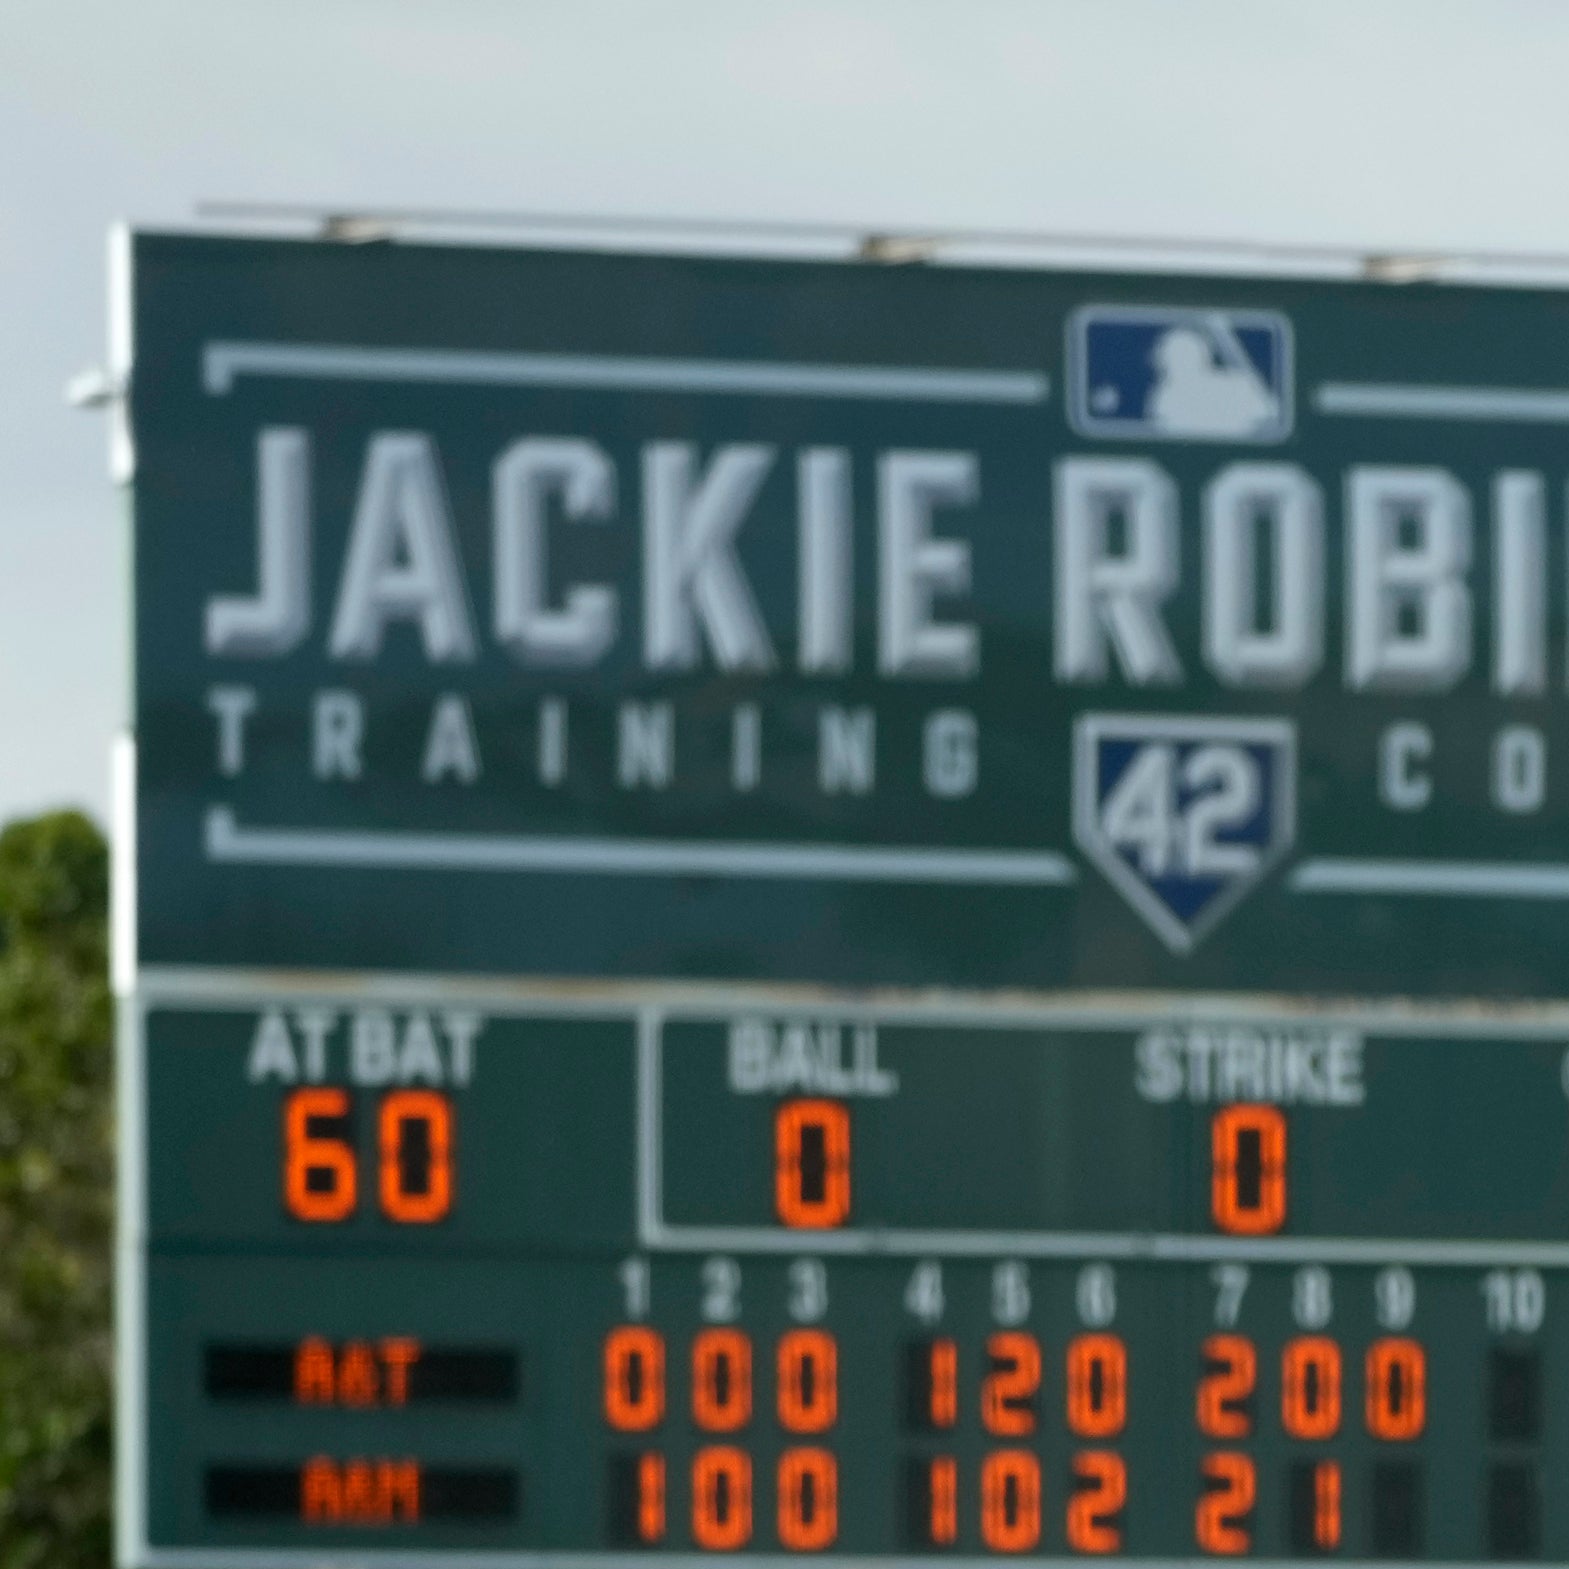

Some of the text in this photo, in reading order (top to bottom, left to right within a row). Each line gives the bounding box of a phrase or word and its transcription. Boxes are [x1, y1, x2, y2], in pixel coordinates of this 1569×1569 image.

[204, 426, 980, 678] JACKIE
[210, 685, 978, 794] TRAINING
[1101, 744, 1262, 878] 42
[249, 1014, 482, 1086] AT BAT
[729, 1021, 896, 1094] BALL
[1135, 1031, 1365, 1108] STRIKE
[283, 1086, 453, 1222] 60
[775, 1098, 851, 1229] 0
[1212, 1103, 1287, 1235] 0
[621, 1258, 651, 1317] 1
[702, 1258, 742, 1322] 2
[790, 1259, 827, 1321] 3
[904, 1261, 943, 1322] 4
[993, 1261, 1031, 1323] 5
[1077, 1263, 1115, 1325] 6
[1212, 1265, 1249, 1326] 7
[1293, 1265, 1332, 1327] 8
[1375, 1267, 1416, 1328] 9
[1483, 1270, 1546, 1333] 10
